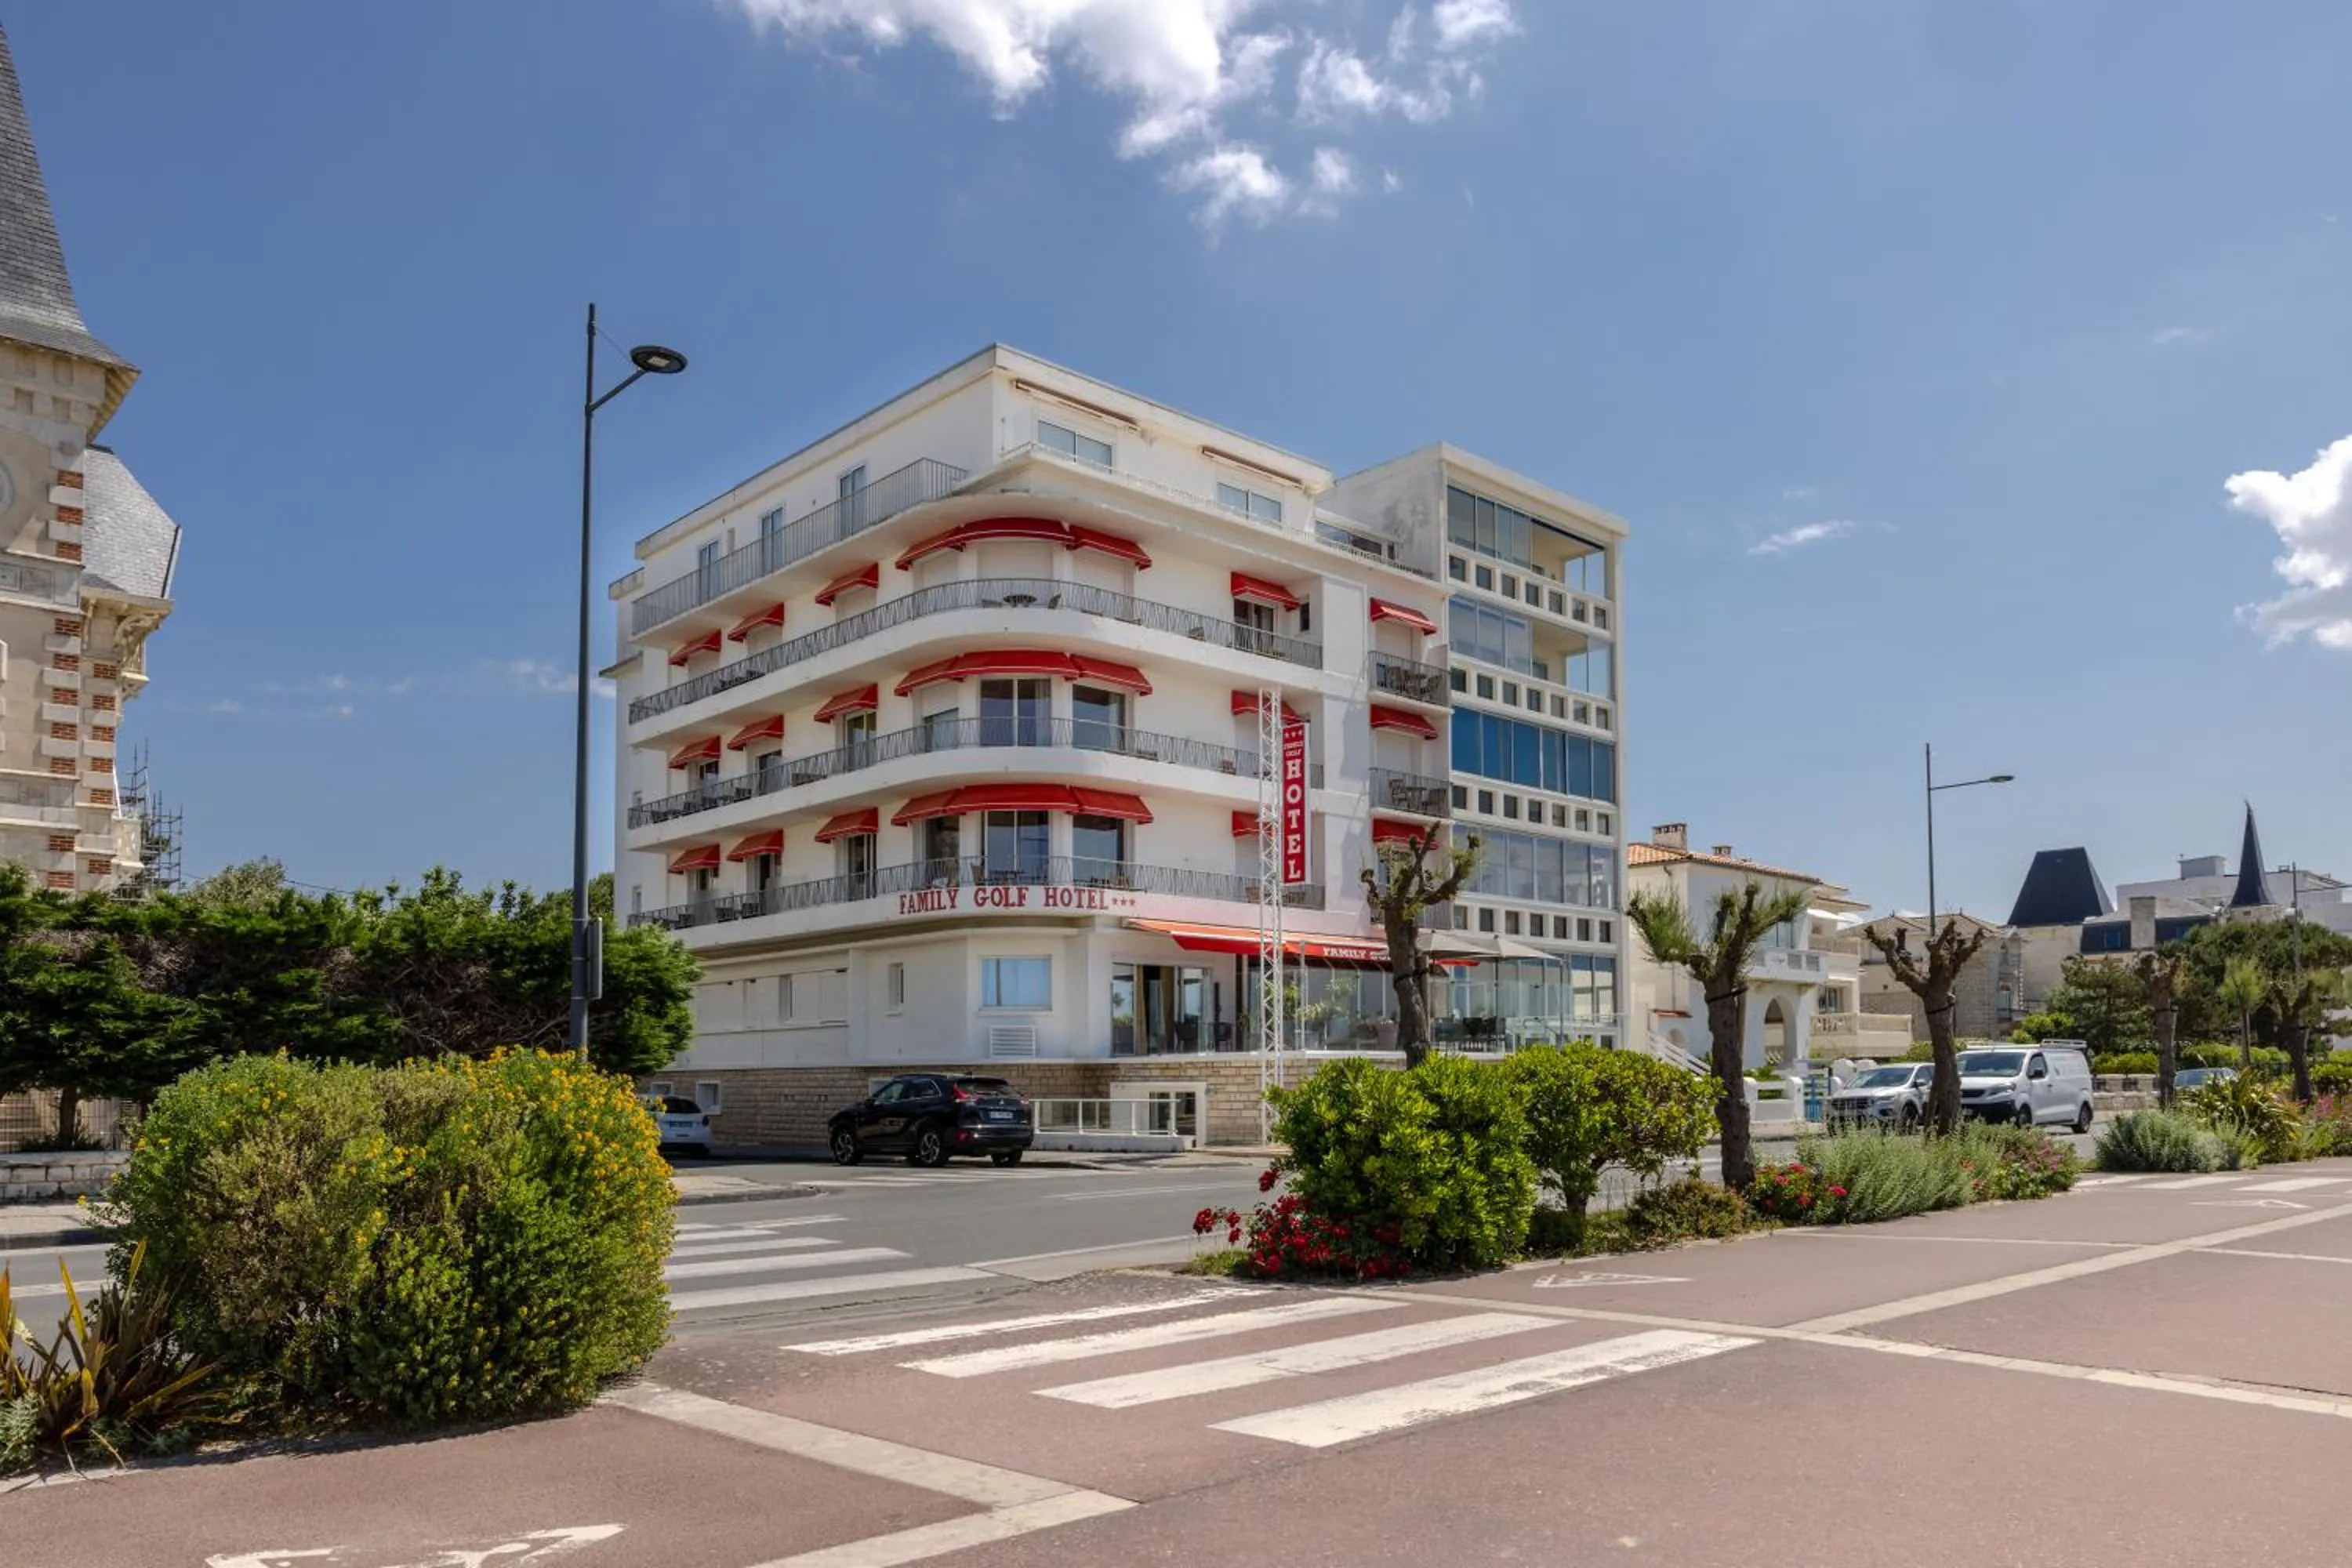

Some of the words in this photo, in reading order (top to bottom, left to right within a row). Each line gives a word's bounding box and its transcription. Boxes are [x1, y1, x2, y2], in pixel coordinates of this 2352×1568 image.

[1286, 758, 1302, 879] HOTEL
[899, 887, 960, 915] FAMILY
[973, 887, 1029, 908] GOLF
[1044, 887, 1109, 910] HOTEL
[1323, 946, 1367, 960] FAMILY
